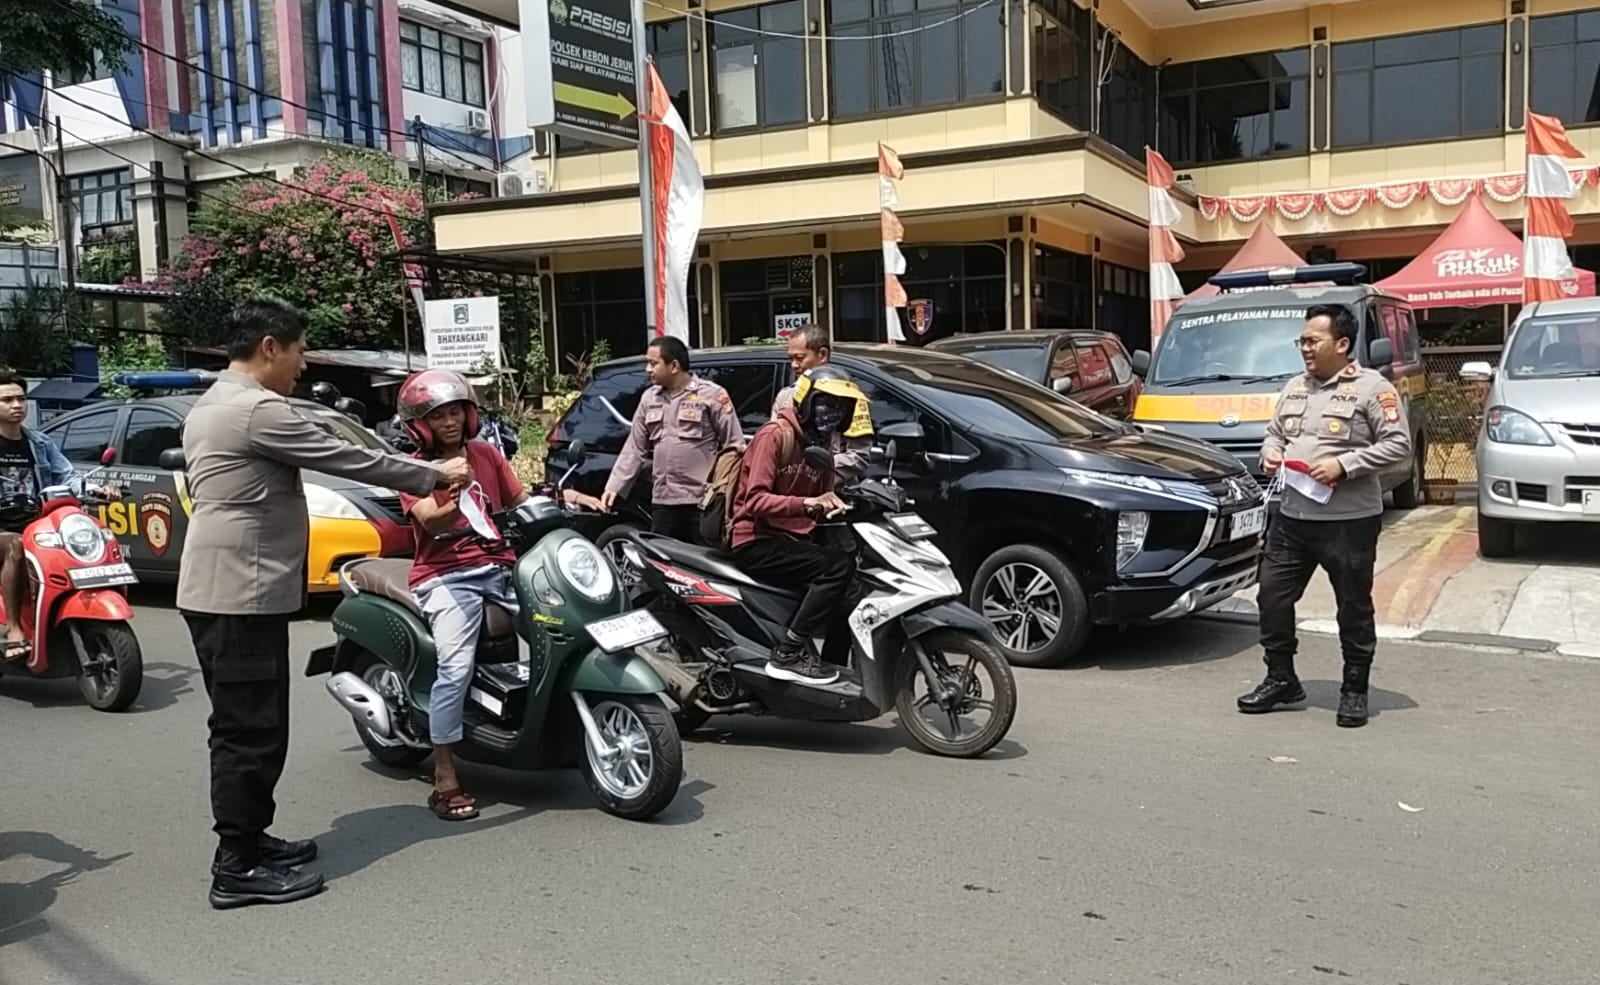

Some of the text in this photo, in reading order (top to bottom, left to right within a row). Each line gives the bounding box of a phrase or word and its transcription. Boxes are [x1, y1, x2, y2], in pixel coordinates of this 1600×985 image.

[570, 6, 631, 36] PRESISI
[550, 39, 633, 72] POLSEK KEBON JERUK
[570, 59, 584, 72] SIAP
[585, 65, 616, 80] MELAYANI
[617, 74, 634, 85] ANDA
[1408, 287, 1523, 302] Rasa Teh Terbaik ada di Pucu
[777, 316, 809, 330] SKCK
[1181, 308, 1307, 330] SENTRA PELAYANAN MASYA
[437, 333, 488, 344] BHAYANGKARI
[1196, 397, 1269, 413] POLISI
[1330, 394, 1358, 403] POLRI
[120, 471, 156, 483] PELANGGAR
